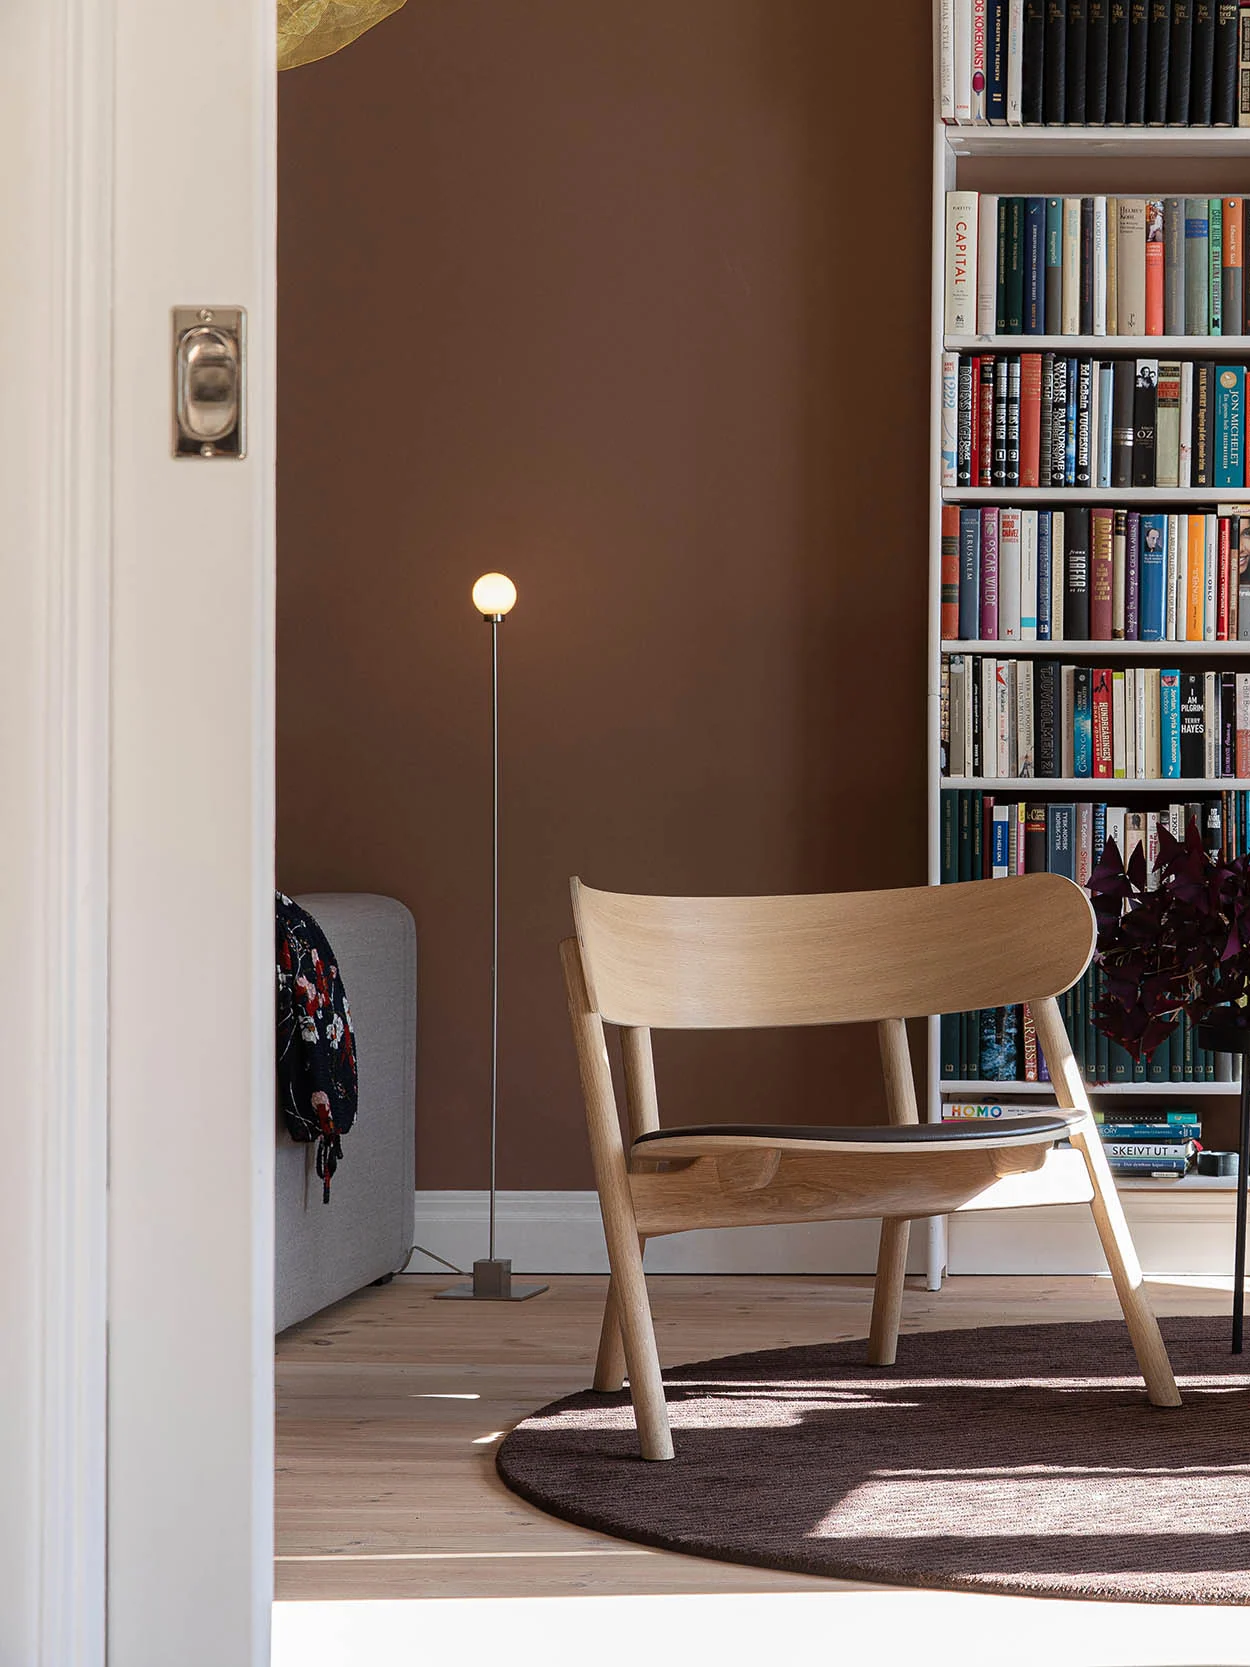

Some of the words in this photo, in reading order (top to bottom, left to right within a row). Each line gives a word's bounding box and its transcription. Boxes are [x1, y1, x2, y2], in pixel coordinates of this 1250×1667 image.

[974, 0, 984, 12] OG
[974, 16, 984, 70] KOKEKUNST
[1096, 211, 1103, 220] EN
[955, 221, 967, 285] CAPITAL
[1080, 363, 1090, 376] Ed
[943, 375, 956, 409] 1222
[959, 365, 972, 411] DØDENS
[1080, 377, 1090, 409] McBain
[1229, 390, 1239, 411] JON
[1058, 408, 1066, 471] PALINDROME
[1078, 411, 1089, 466] VUGGESANG
[1137, 431, 1154, 439] OZ
[1229, 413, 1239, 467] MICHELET
[1095, 516, 1112, 561] ARAFAT
[966, 529, 974, 581] JERUSALEM
[984, 539, 995, 574] OSCAR
[1069, 556, 1087, 588] KAFKA
[984, 575, 995, 607] WILDE
[1170, 688, 1178, 711] Jordan,
[1187, 696, 1198, 704] AM
[1242, 685, 1250, 700] Bill
[1040, 665, 1055, 760] TJUVHOLMEN
[1170, 712, 1178, 729] Syria
[1181, 704, 1204, 712] PILGRIM
[1242, 700, 1250, 727] Bryson
[1098, 702, 1112, 762] HUNDREÅRINGEN
[1181, 724, 1205, 733] HAYES
[1170, 736, 1178, 764] Lebanon
[1081, 810, 1089, 823] Tom
[1024, 1016, 1037, 1060] ARABS
[952, 1105, 1002, 1118] HOMO
[1112, 1146, 1151, 1156] SKEIVT
[1154, 1146, 1168, 1155] UT
